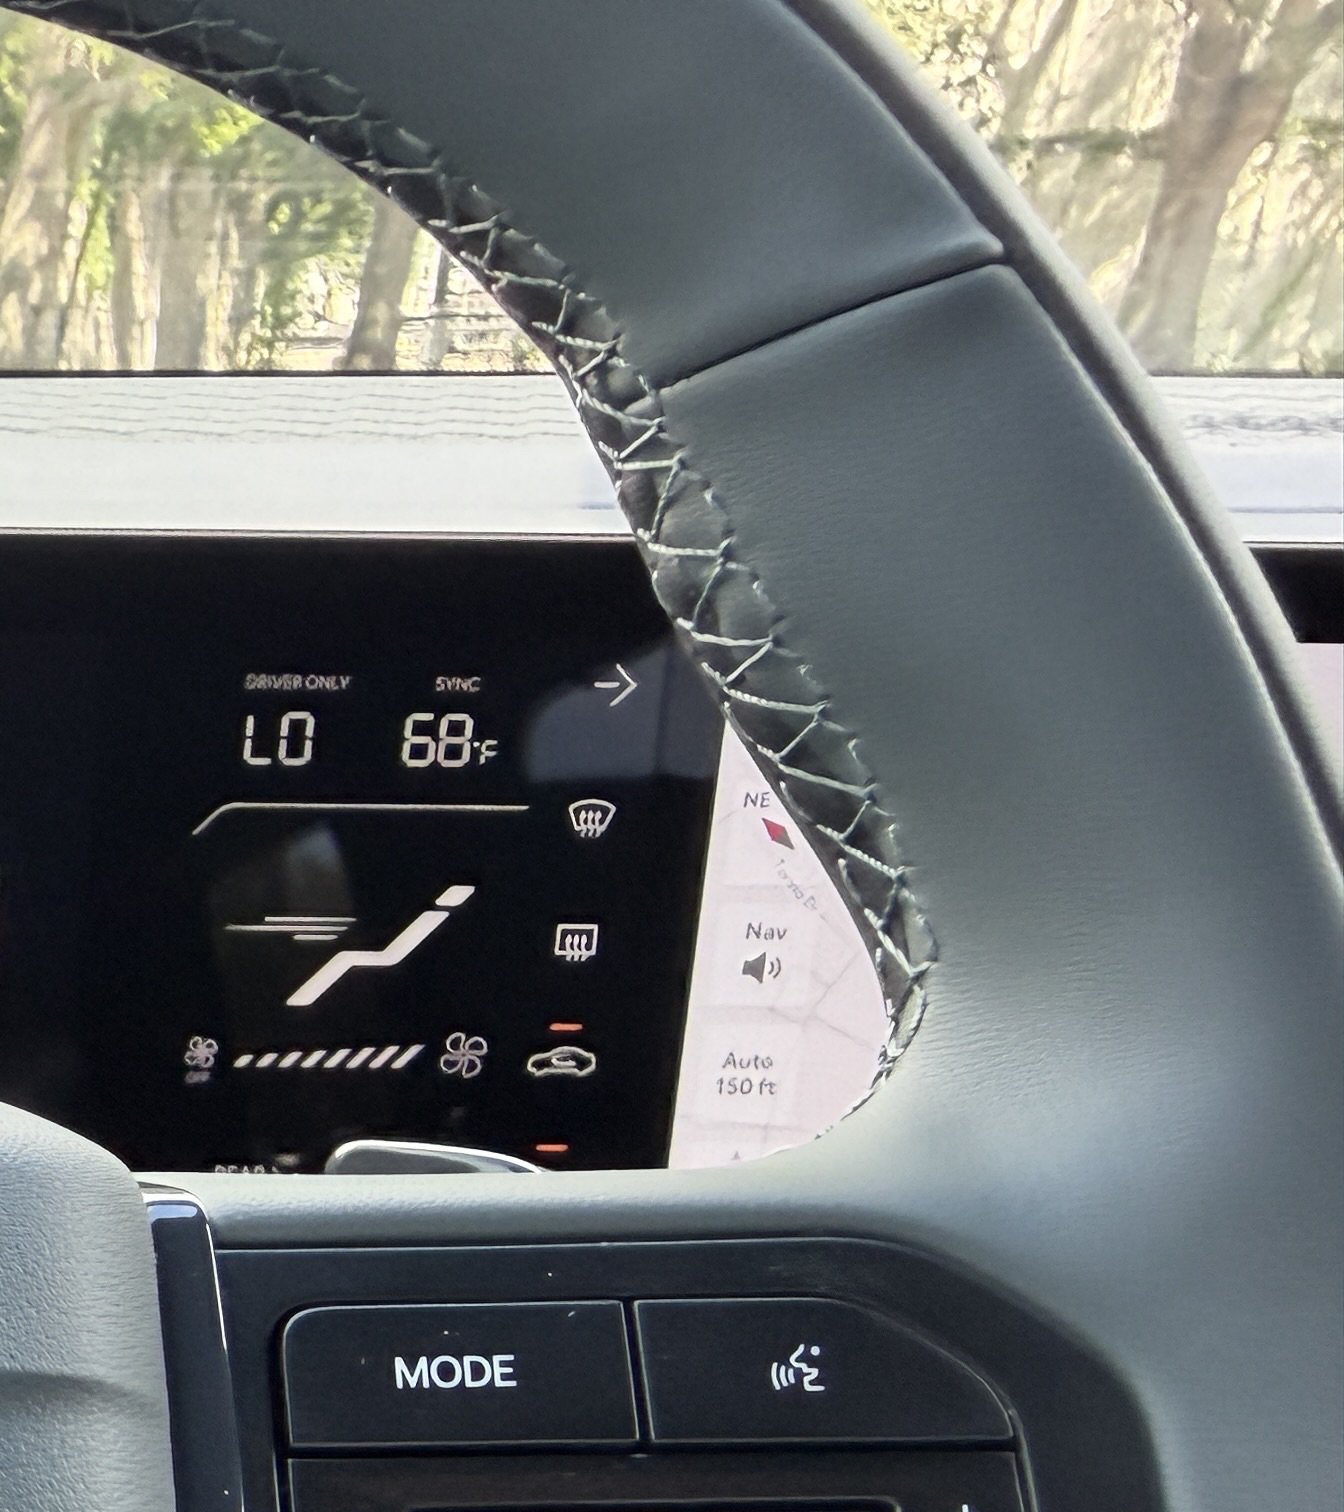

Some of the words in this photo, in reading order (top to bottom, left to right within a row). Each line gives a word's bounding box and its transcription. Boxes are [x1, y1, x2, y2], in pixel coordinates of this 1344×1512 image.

[305, 673, 351, 691] ONLY
[434, 675, 482, 692] SYNC
[743, 791, 771, 808] NE
[745, 921, 788, 941] Nav
[721, 1051, 774, 1071] Auto
[715, 1078, 753, 1096] 150
[757, 1078, 778, 1096] ft
[394, 1354, 516, 1390] MODE
